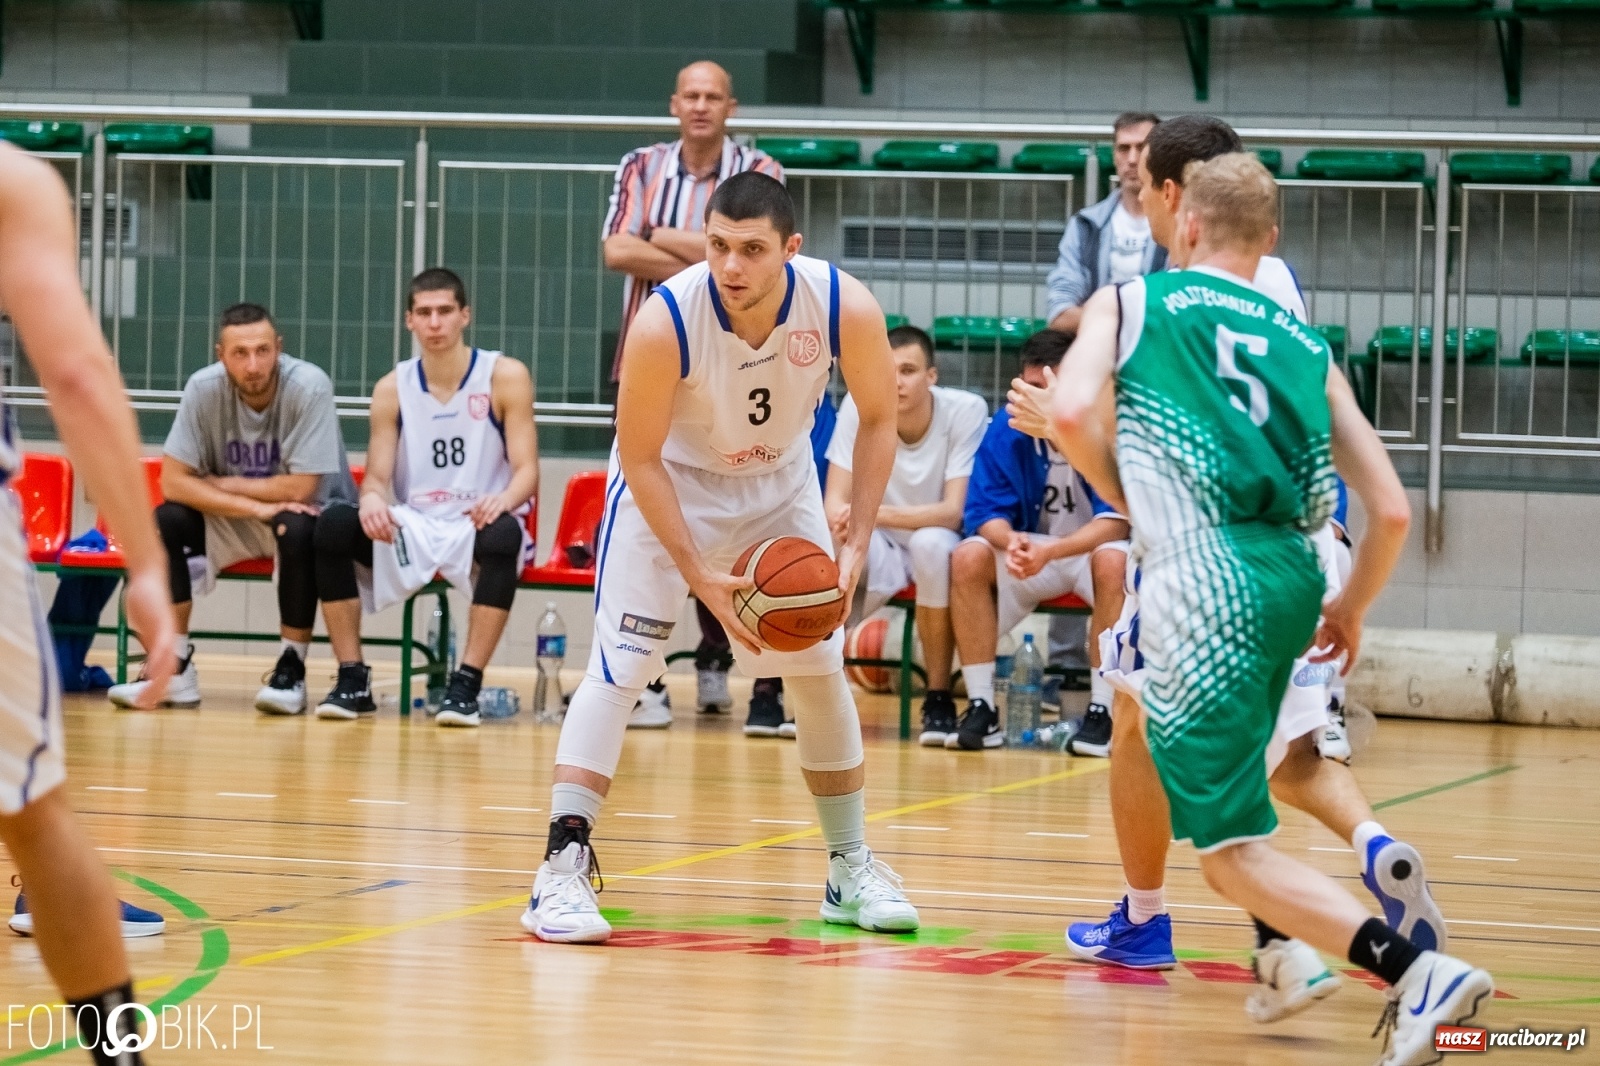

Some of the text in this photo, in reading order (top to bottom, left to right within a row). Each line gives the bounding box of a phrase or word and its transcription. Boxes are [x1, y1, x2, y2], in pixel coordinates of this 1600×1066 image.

[1215, 323, 1270, 427] 5
[748, 387, 772, 426] 3
[432, 437, 465, 468] 88
[1044, 485, 1076, 513] 24
